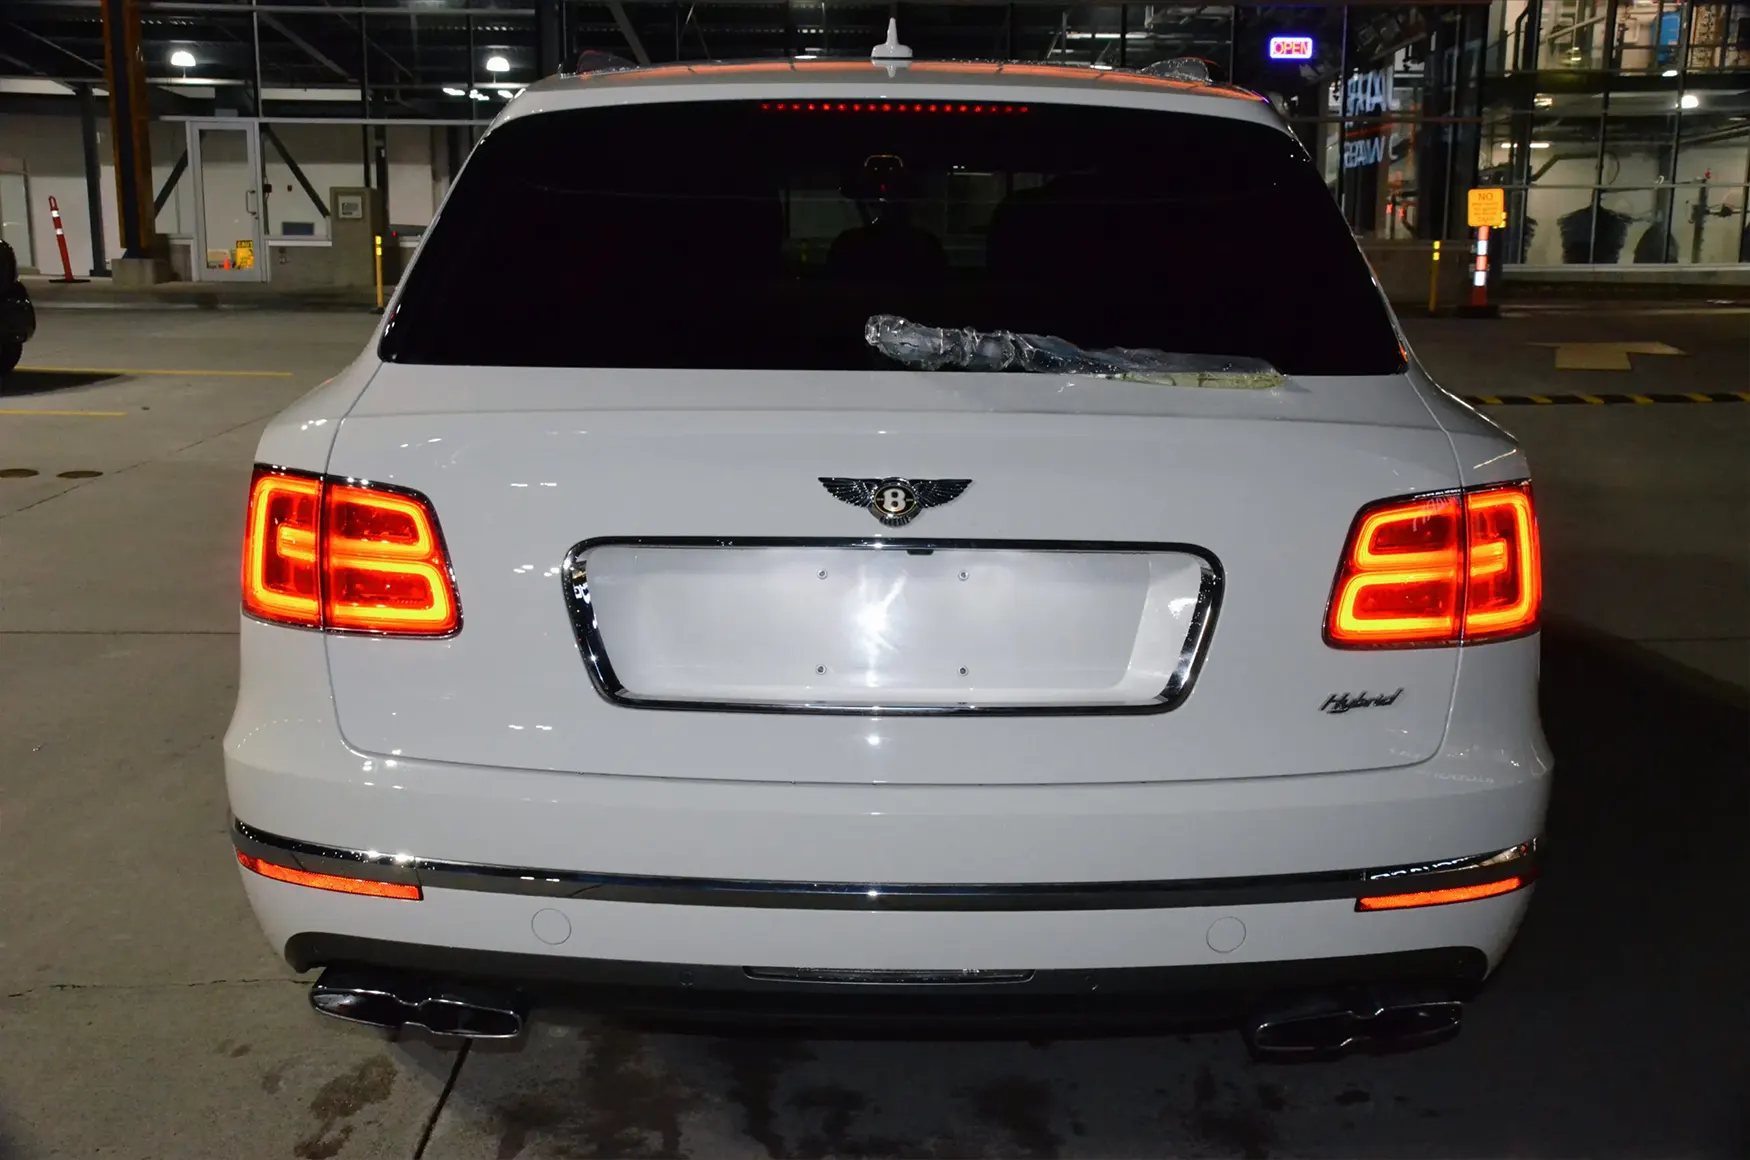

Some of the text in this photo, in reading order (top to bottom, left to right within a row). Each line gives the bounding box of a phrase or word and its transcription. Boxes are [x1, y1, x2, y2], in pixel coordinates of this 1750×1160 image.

[1274, 41, 1309, 55] OPEN
[1477, 192, 1494, 202] NO
[882, 488, 906, 512] B
[1318, 687, 1404, 714] Hybrid
